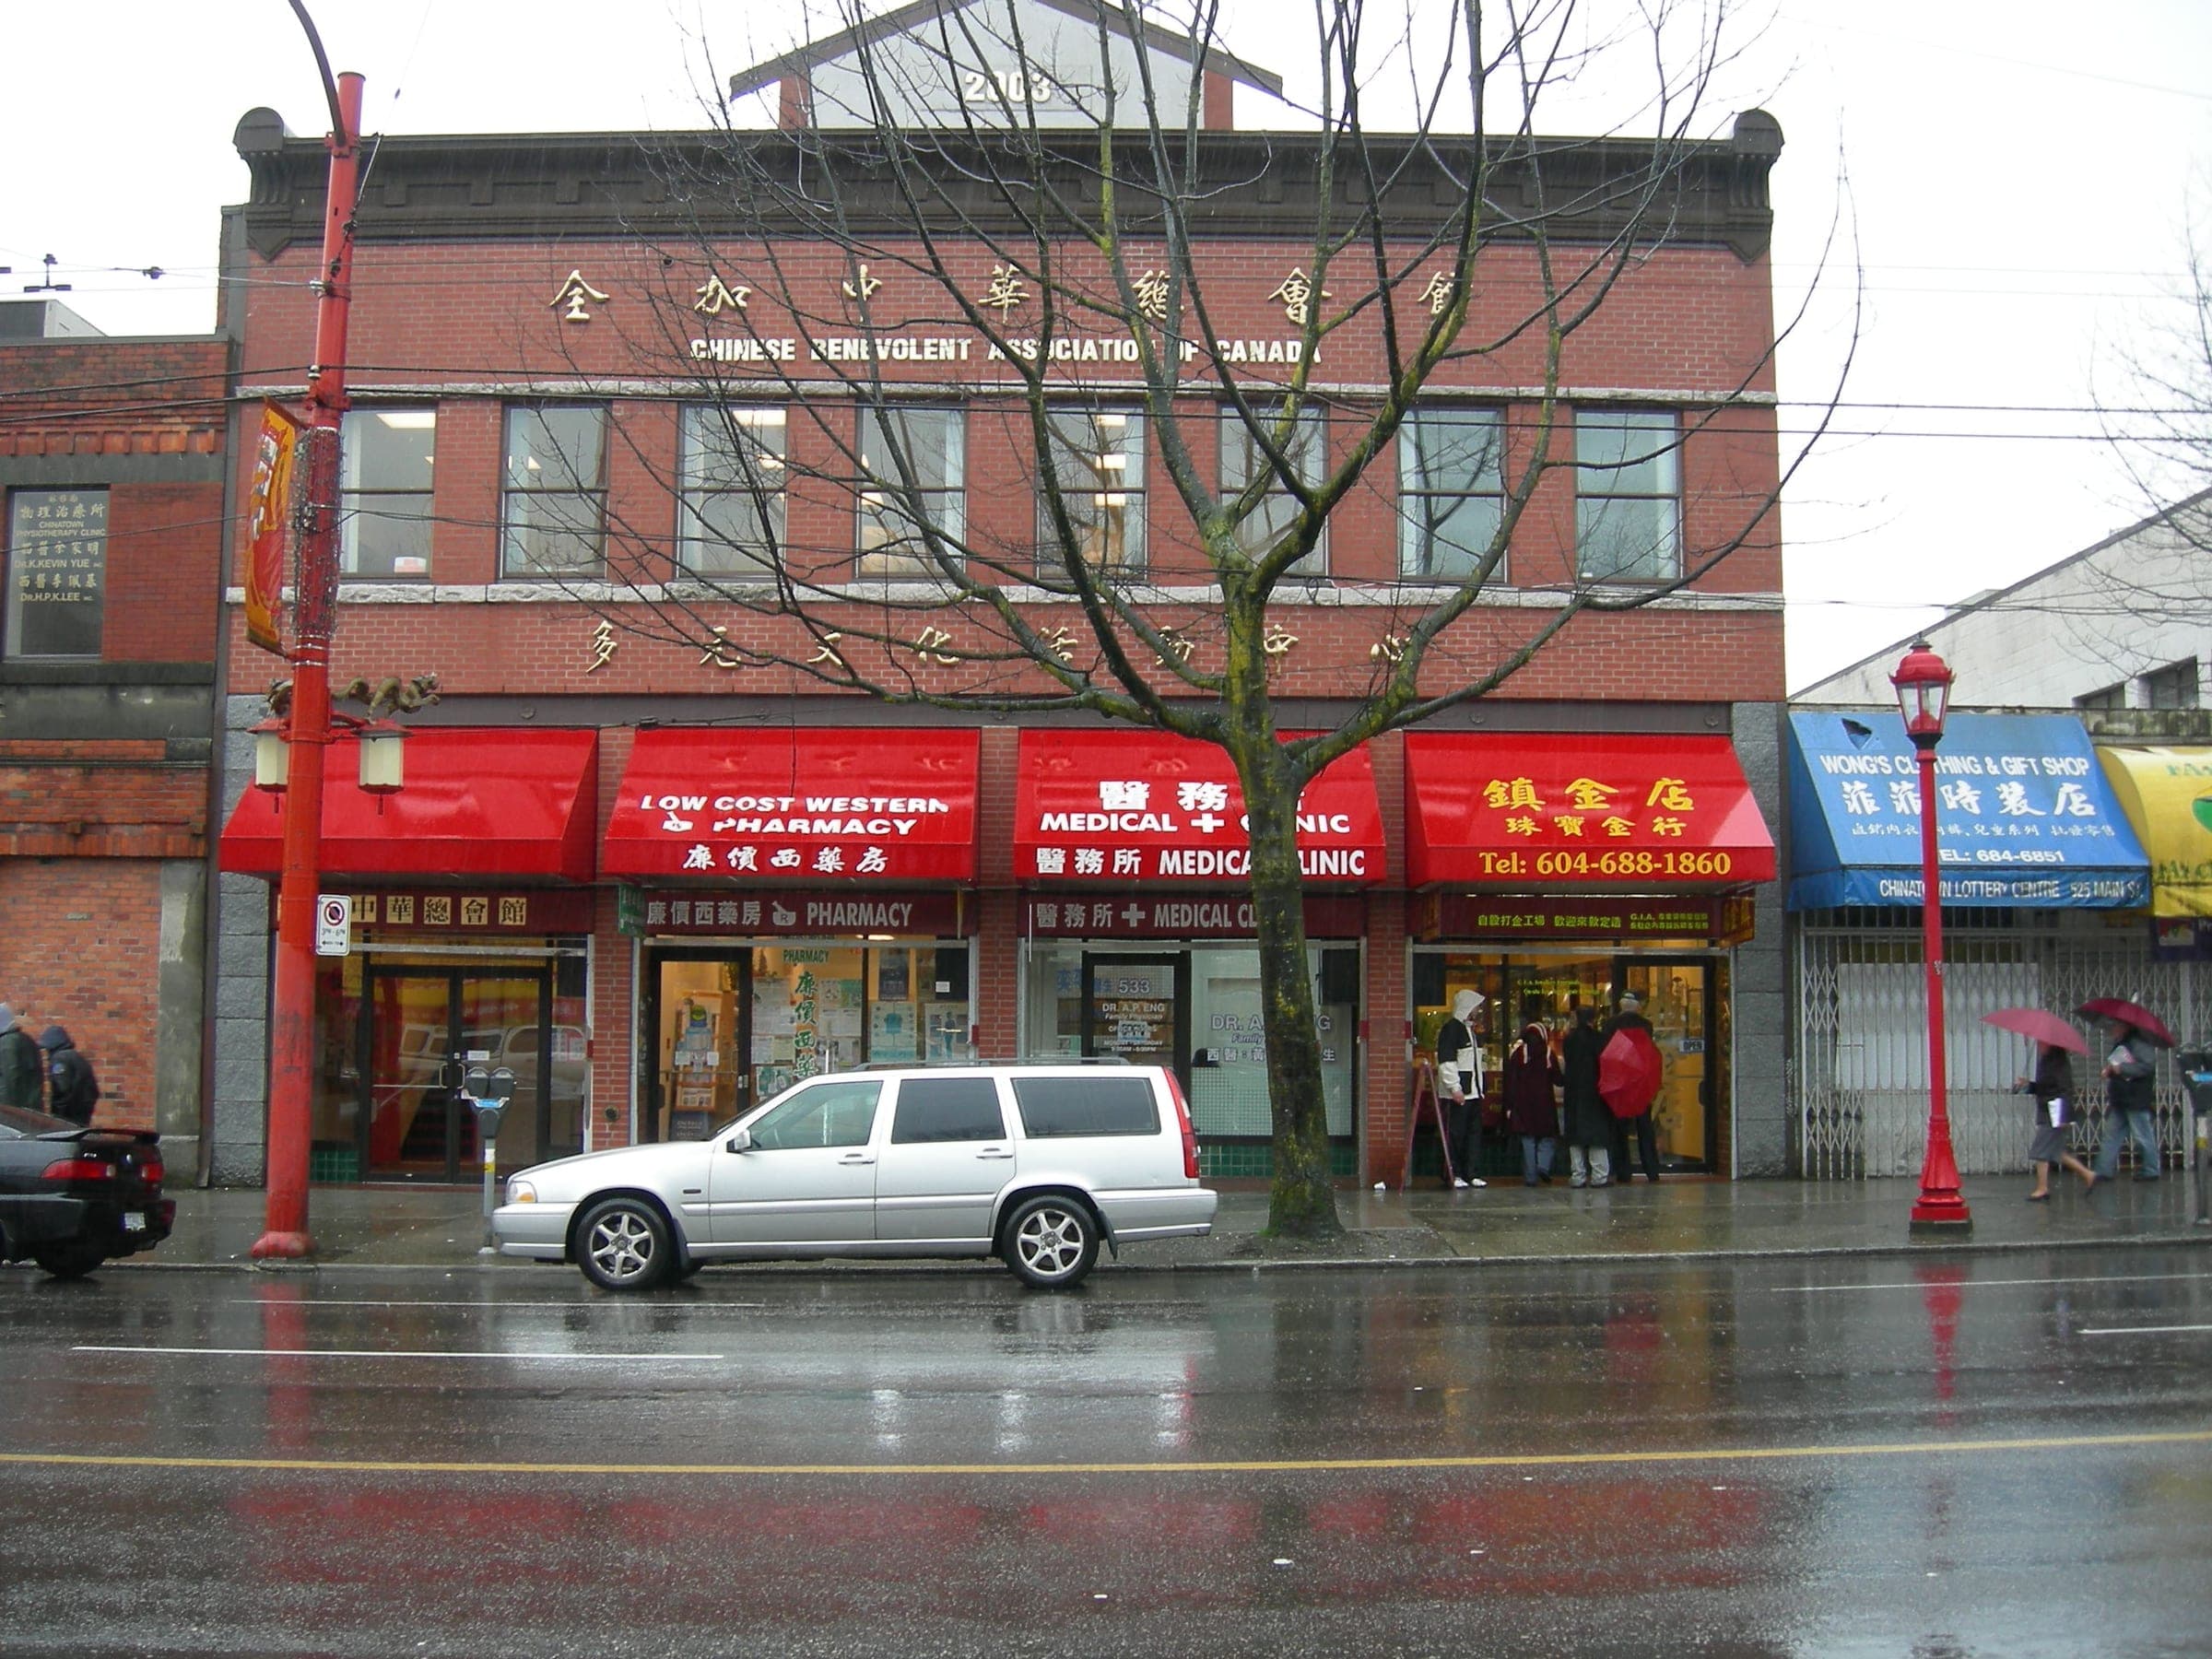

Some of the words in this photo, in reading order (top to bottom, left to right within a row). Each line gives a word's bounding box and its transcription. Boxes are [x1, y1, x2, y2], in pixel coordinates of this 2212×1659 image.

[964, 70, 1052, 103] 2003
[690, 337, 796, 362] CHINESE
[810, 337, 972, 362] BENEVOLENT
[987, 338, 1156, 362] ASSCIATIO
[15, 529, 77, 537] PHYSIOTHERAPY
[80, 528, 106, 536] CLINIC
[39, 521, 85, 529] CHINATOWN
[71, 559, 89, 569] YUE
[1819, 755, 1893, 775] WONG'S
[1894, 756, 1983, 776] CLTHING
[1985, 759, 2000, 775] &
[2001, 758, 2042, 776] GIFT
[2045, 759, 2090, 777] SHOP
[640, 794, 708, 812] LOW
[714, 795, 795, 813] COST
[805, 797, 950, 815] WESTERN
[1482, 777, 1695, 812] 鎮金店
[712, 817, 917, 836] PHARMACY
[1040, 812, 1178, 833] MEDICAL
[1504, 815, 1688, 838] 珠寶金行
[682, 843, 890, 875] 廉價西藥房
[1036, 847, 1142, 876] 醫務所
[1159, 850, 1253, 876] MEDICA
[1299, 850, 1365, 877] LINIC
[1479, 852, 1527, 875] Tel:
[1535, 851, 1732, 876] 604-688-1860
[1976, 849, 2065, 864] 684-6851
[1879, 879, 1951, 898] CHINATN
[1954, 879, 2008, 898] LOTTERY
[2012, 881, 2060, 899] CENTRE
[2070, 882, 2091, 899] 525
[2093, 881, 2125, 899] MAIN
[351, 896, 527, 925] 中華總會館
[646, 900, 762, 927] 廉價西藥房
[806, 902, 913, 927] PHARMACY
[1036, 903, 1113, 928] 醫務所
[1154, 903, 1232, 928] MEDICAL
[782, 949, 830, 963] PHARMACY
[1118, 979, 1151, 994] 533
[1143, 1003, 1165, 1012] ENG
[1210, 1015, 1244, 1030] DR.
